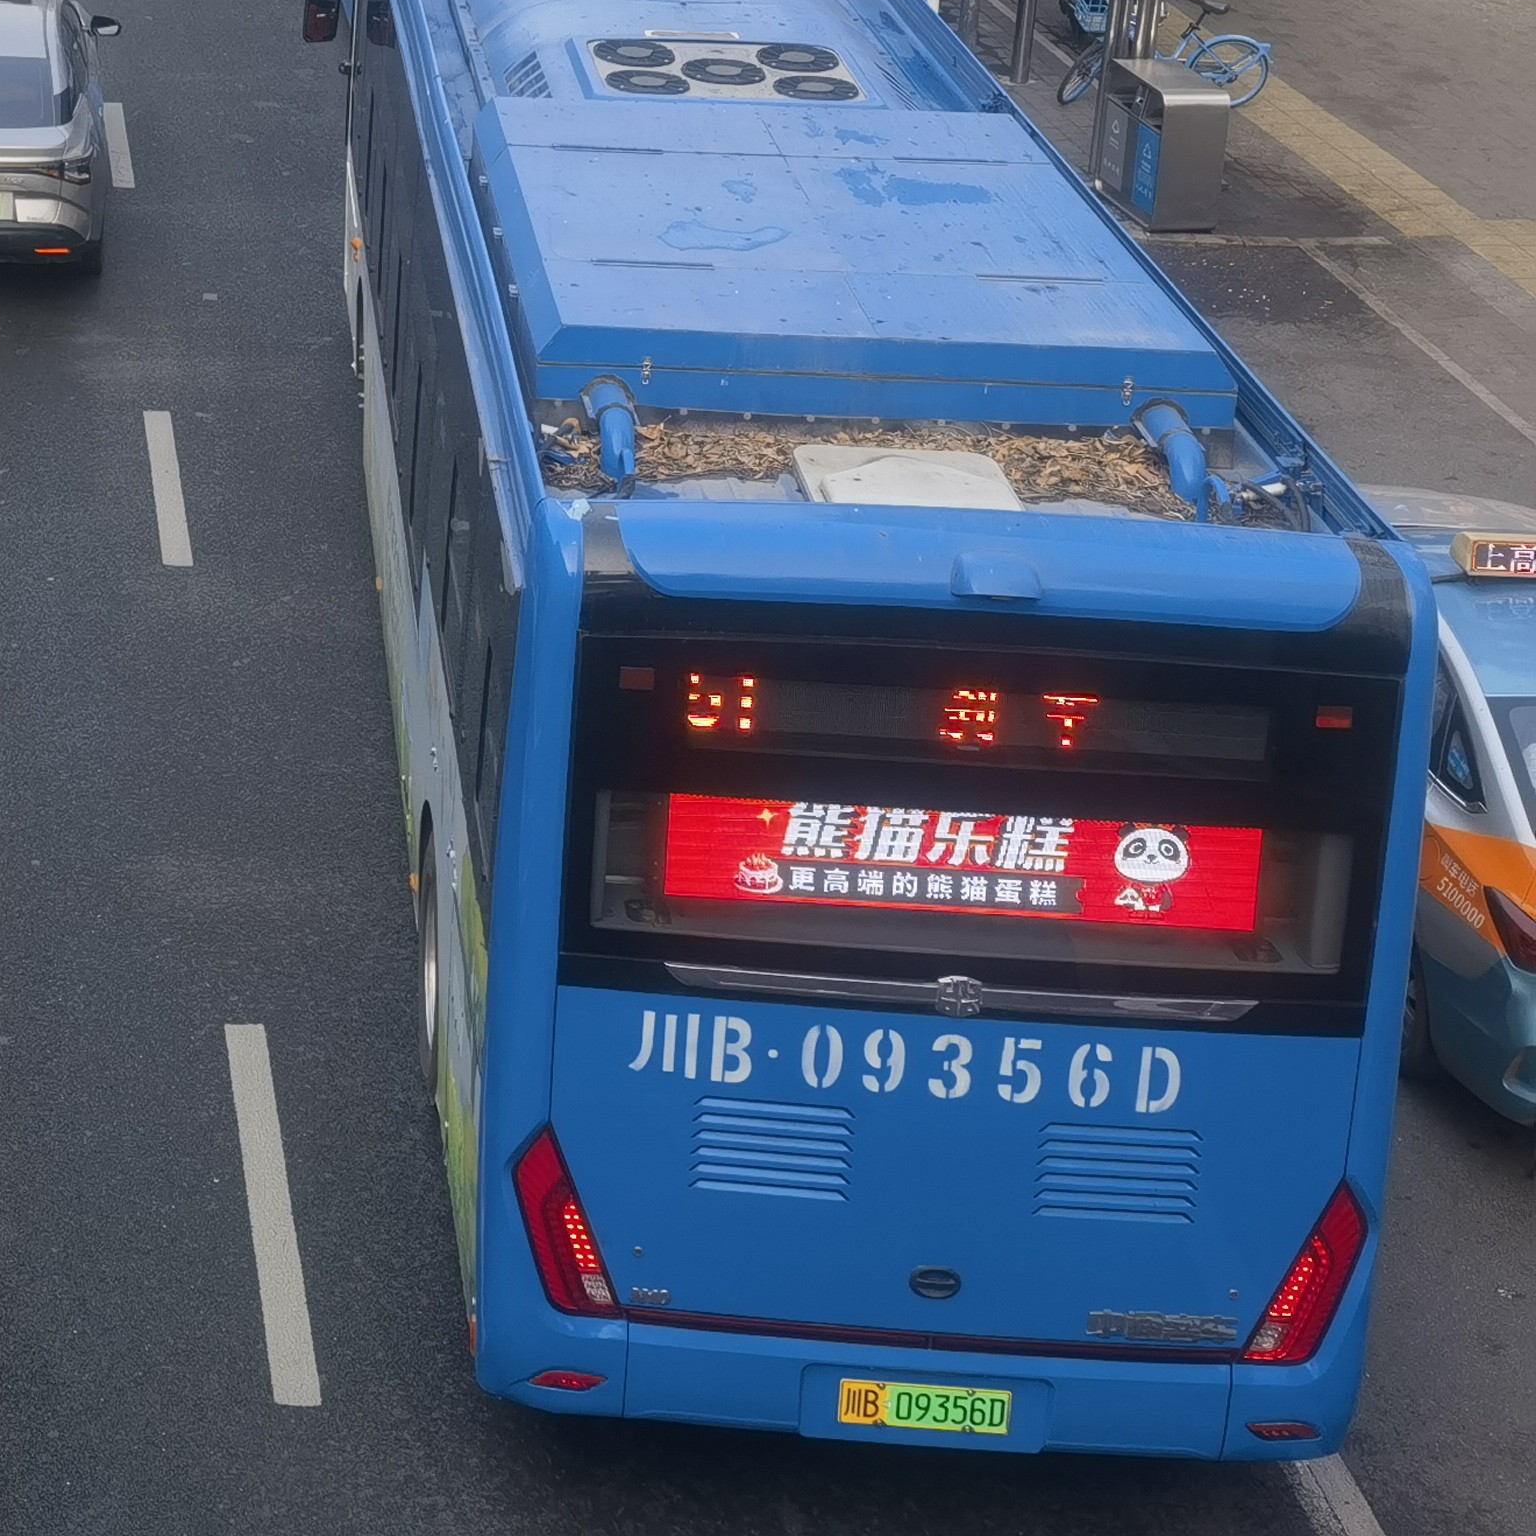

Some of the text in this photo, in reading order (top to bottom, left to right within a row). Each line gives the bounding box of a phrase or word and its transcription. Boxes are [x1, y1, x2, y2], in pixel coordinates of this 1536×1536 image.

[789, 865, 1058, 906] 更高端的熊猫蛋糕
[1440, 853, 1479, 897] 叫车电话
[1436, 876, 1486, 929] 5100000
